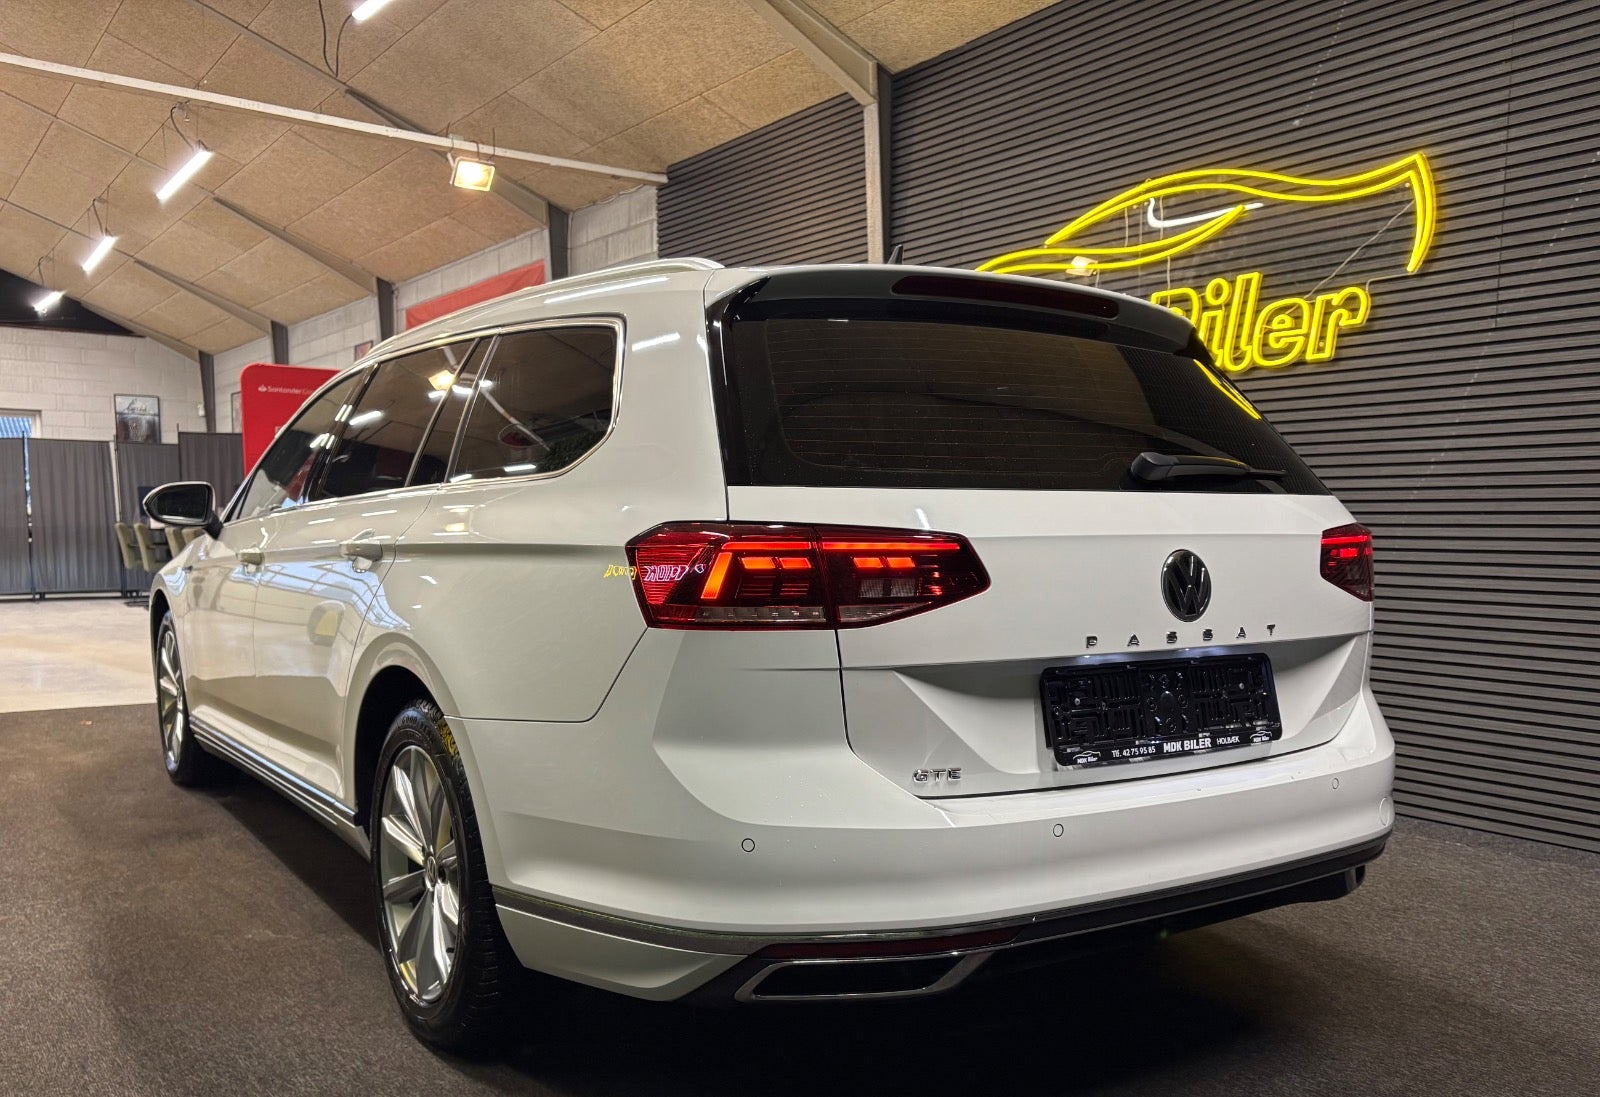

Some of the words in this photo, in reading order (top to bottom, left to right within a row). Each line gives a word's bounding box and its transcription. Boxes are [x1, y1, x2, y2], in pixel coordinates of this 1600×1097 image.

[267, 385, 301, 394] Santander
[1086, 624, 1276, 648] PASSAT
[1122, 748, 1130, 756] 42
[1130, 747, 1139, 755] 75
[1139, 746, 1147, 754] 95
[1163, 740, 1182, 753] MDK
[1184, 737, 1212, 750] BILER
[913, 767, 962, 782] GTE
